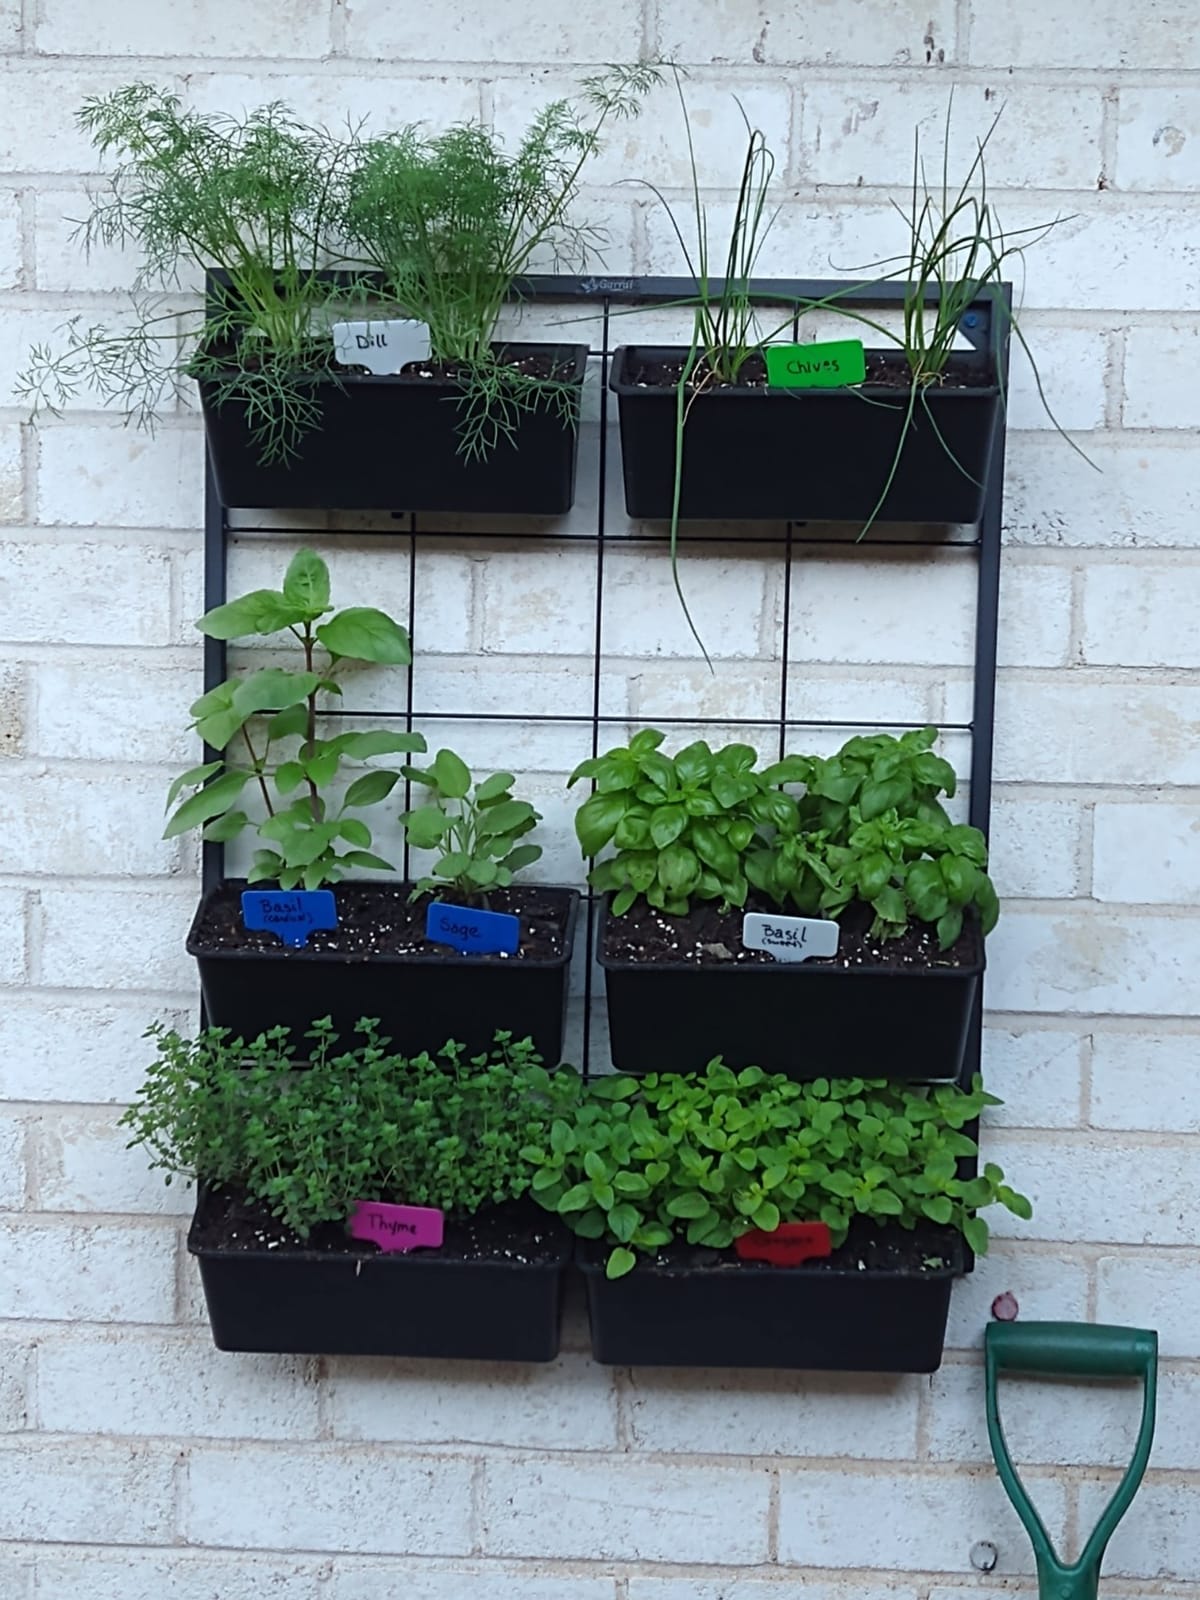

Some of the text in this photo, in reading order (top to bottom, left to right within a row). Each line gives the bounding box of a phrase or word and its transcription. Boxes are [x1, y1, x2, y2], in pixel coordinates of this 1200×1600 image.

[356, 334, 387, 349] Dill
[786, 360, 840, 374] Chives
[260, 897, 302, 913] Basil
[440, 917, 481, 941] Sage
[761, 924, 807, 943] Basil
[368, 1213, 417, 1236] Thyme
